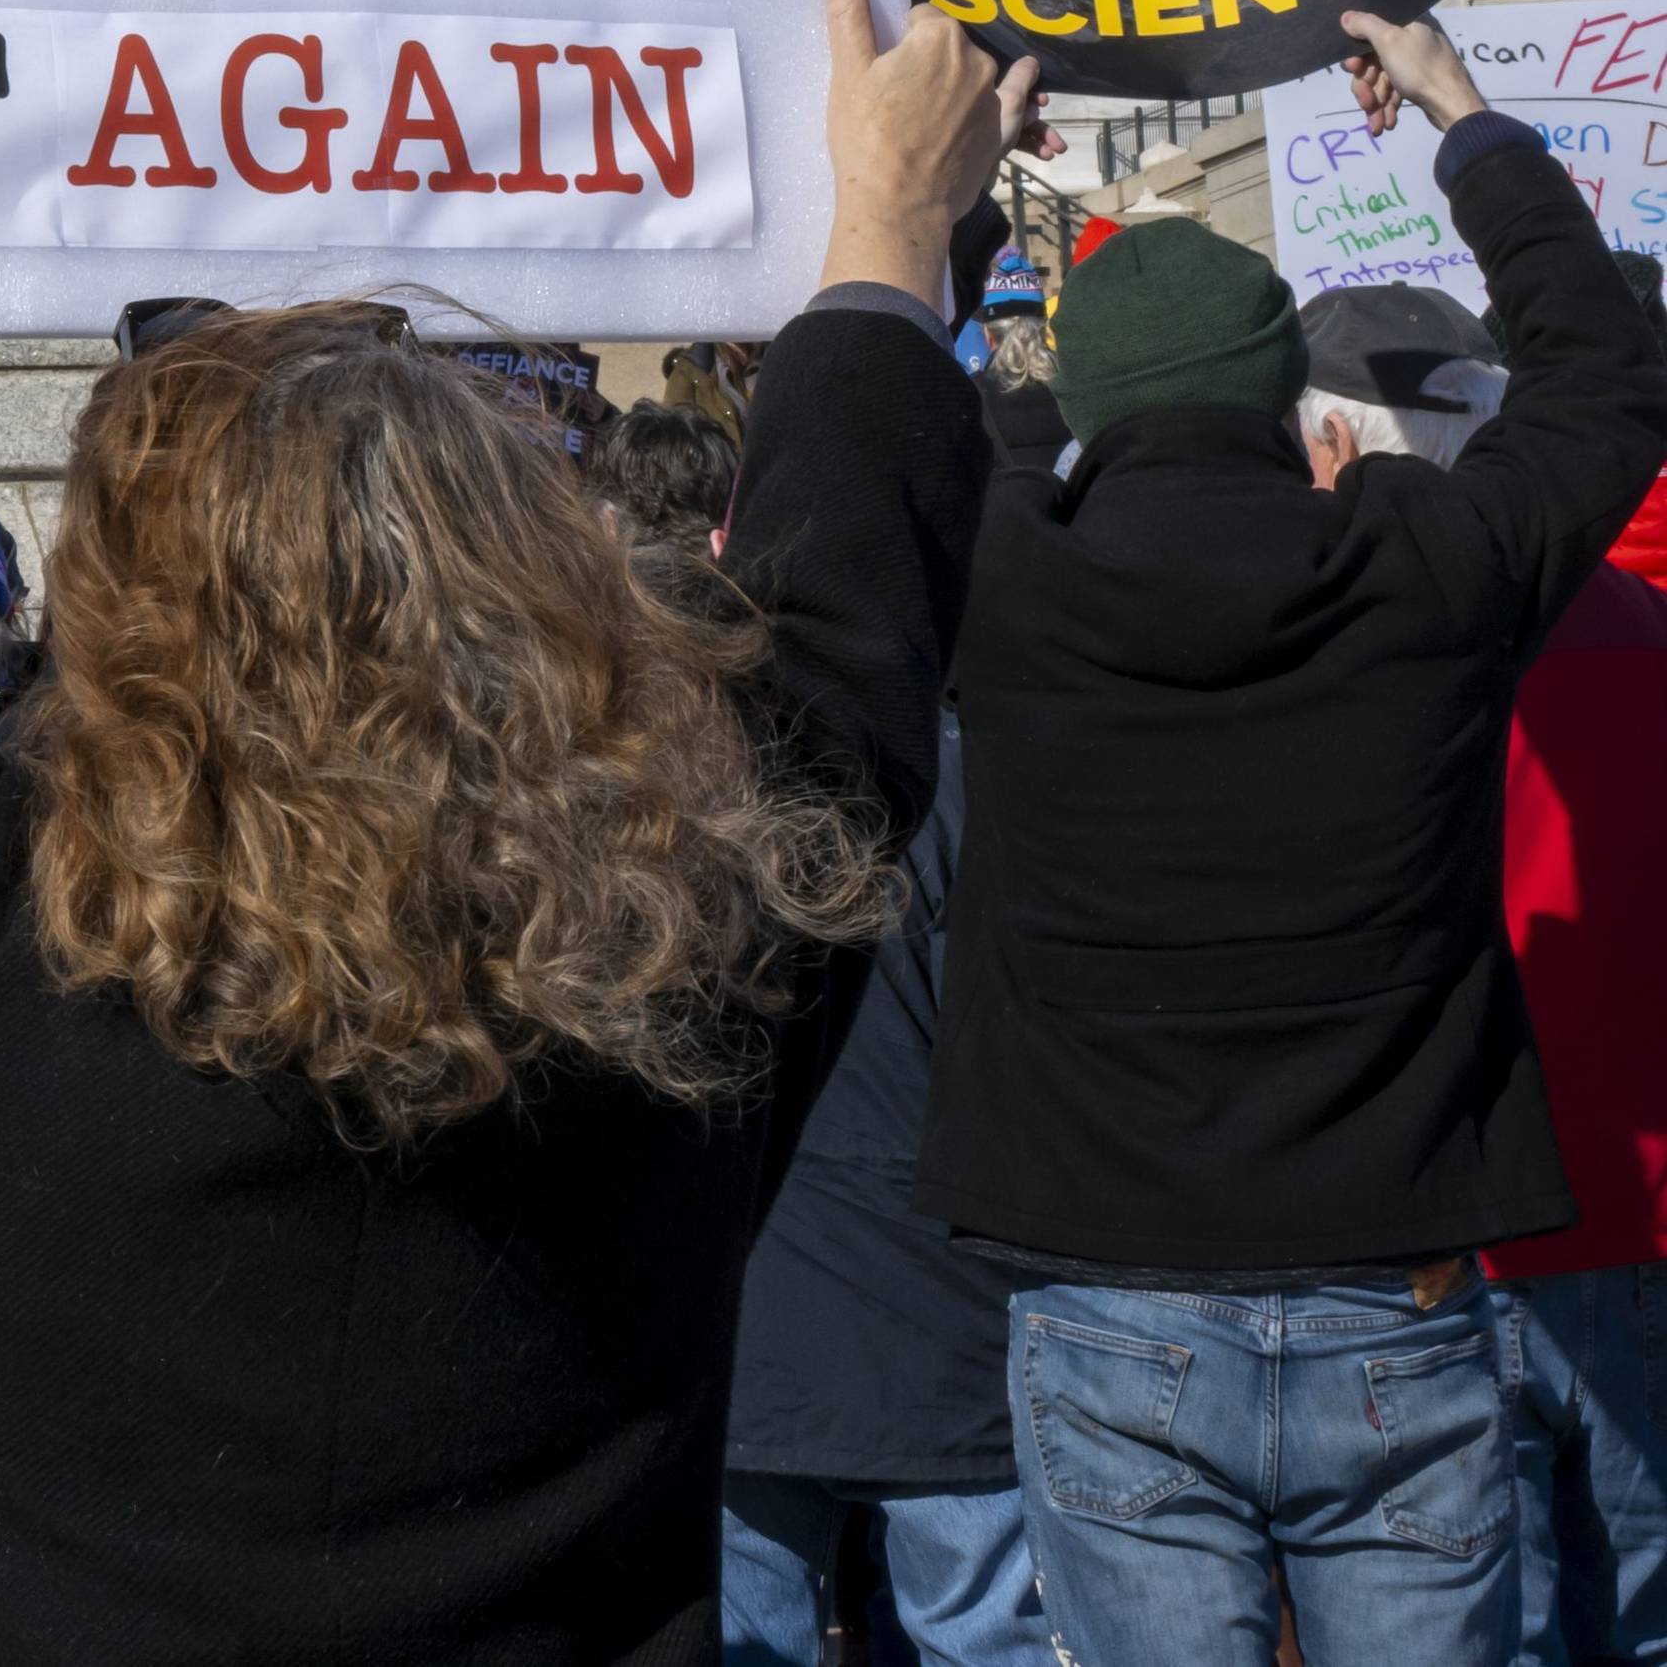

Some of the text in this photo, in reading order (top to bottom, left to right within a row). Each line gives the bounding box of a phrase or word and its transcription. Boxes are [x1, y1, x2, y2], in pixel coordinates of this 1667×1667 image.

[1555, 11, 1667, 93] FE
[67, 33, 703, 199] AGAIN
[1293, 173, 1408, 235] Critical
[1326, 212, 1442, 258] Thinking
[1304, 249, 1475, 292] Introspec
